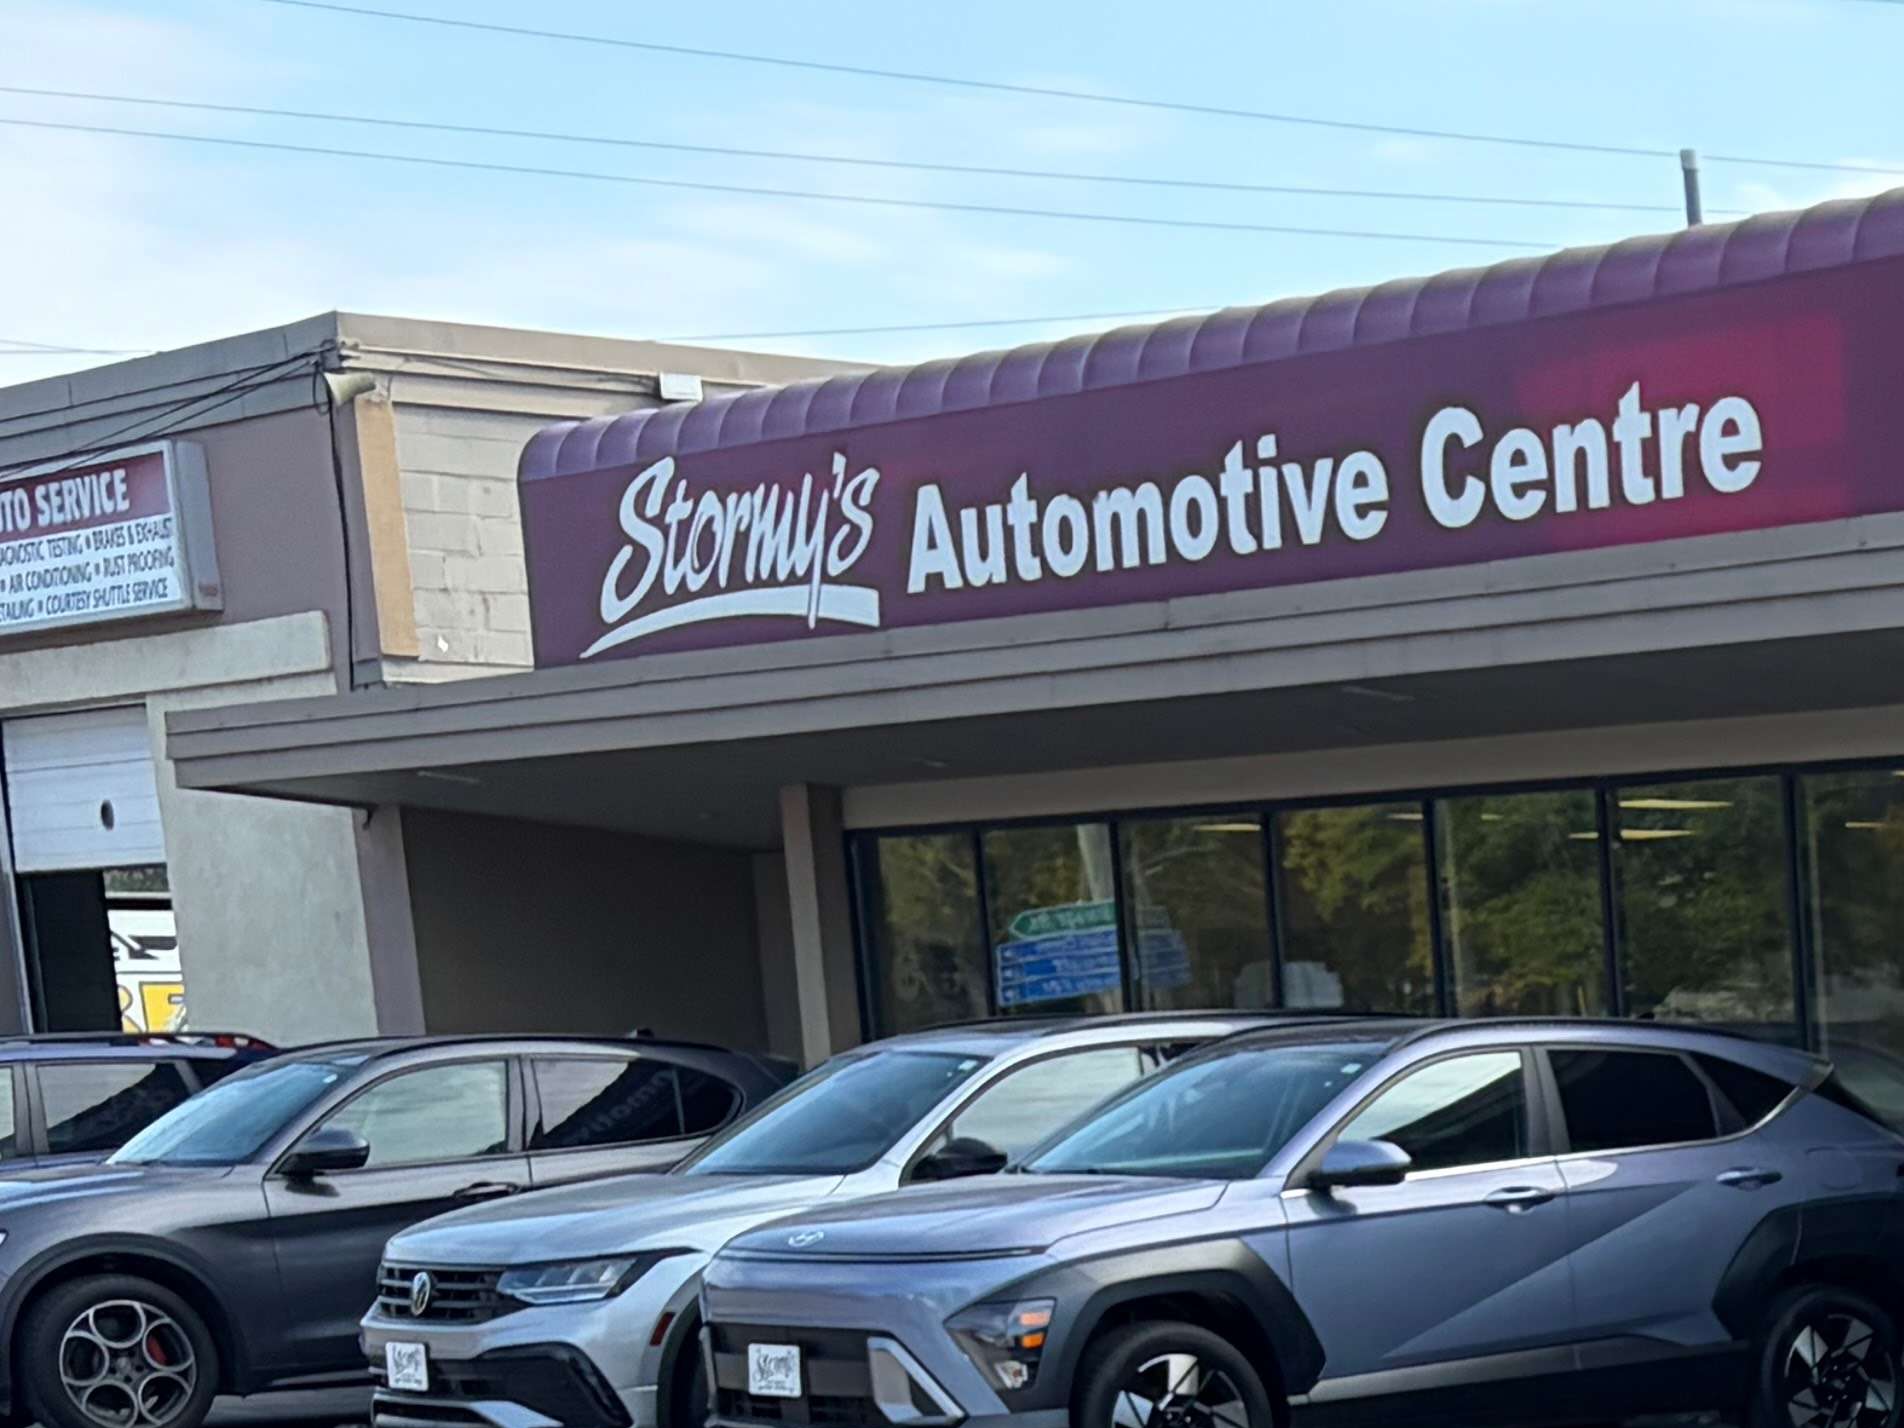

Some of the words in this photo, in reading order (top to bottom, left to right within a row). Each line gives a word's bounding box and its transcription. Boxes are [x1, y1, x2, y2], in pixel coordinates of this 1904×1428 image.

[0, 488, 31, 532] TO
[35, 468, 130, 528] SERVICE
[600, 451, 881, 629] Stormy's
[906, 433, 1390, 594] Automotive
[1420, 381, 1763, 530] Centre
[9, 573, 24, 595] AIR
[26, 561, 92, 592] CONDITIONING
[103, 555, 126, 578] RUST
[127, 545, 175, 575] PROOFING
[46, 533, 83, 558] TESTING
[46, 591, 91, 615] COURTESY
[93, 583, 130, 609] SHUTTLE
[133, 577, 168, 602] SERVICE
